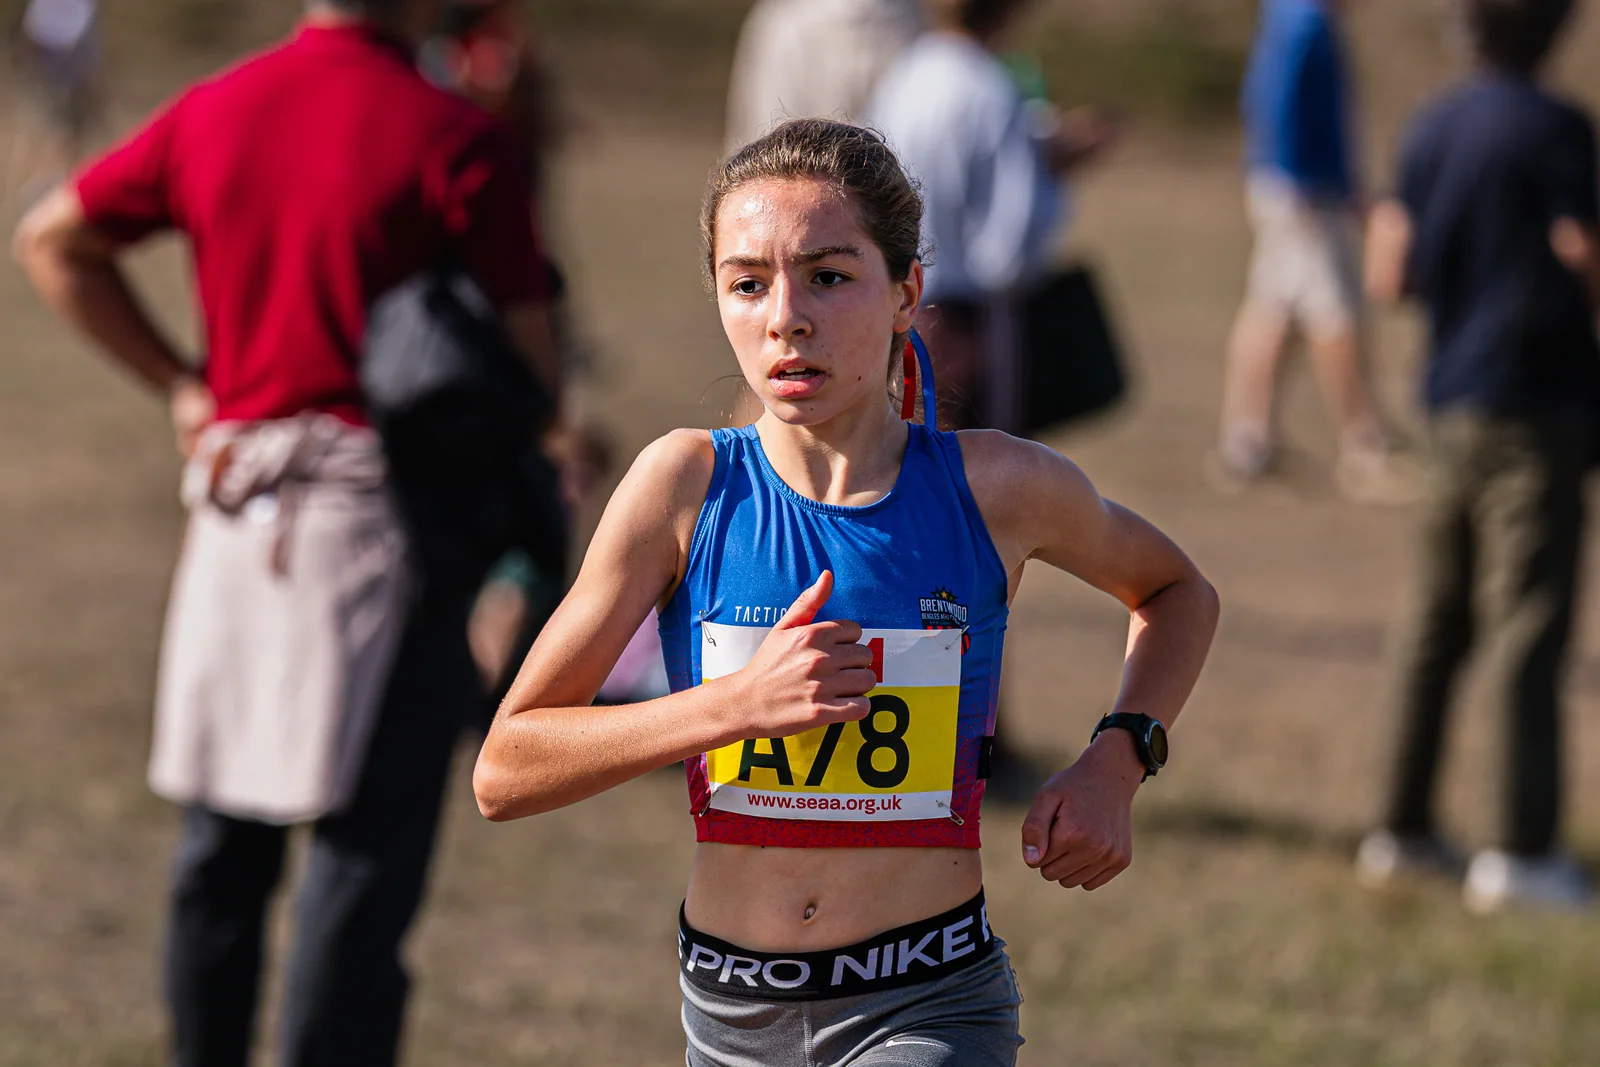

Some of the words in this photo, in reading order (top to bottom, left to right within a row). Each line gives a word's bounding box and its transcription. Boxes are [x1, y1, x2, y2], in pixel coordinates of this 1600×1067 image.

[920, 598, 967, 622] BRENTWOOD
[747, 793, 902, 814] www.seaa.org.uk
[686, 942, 811, 989] PRO
[830, 915, 976, 986] NIKE
